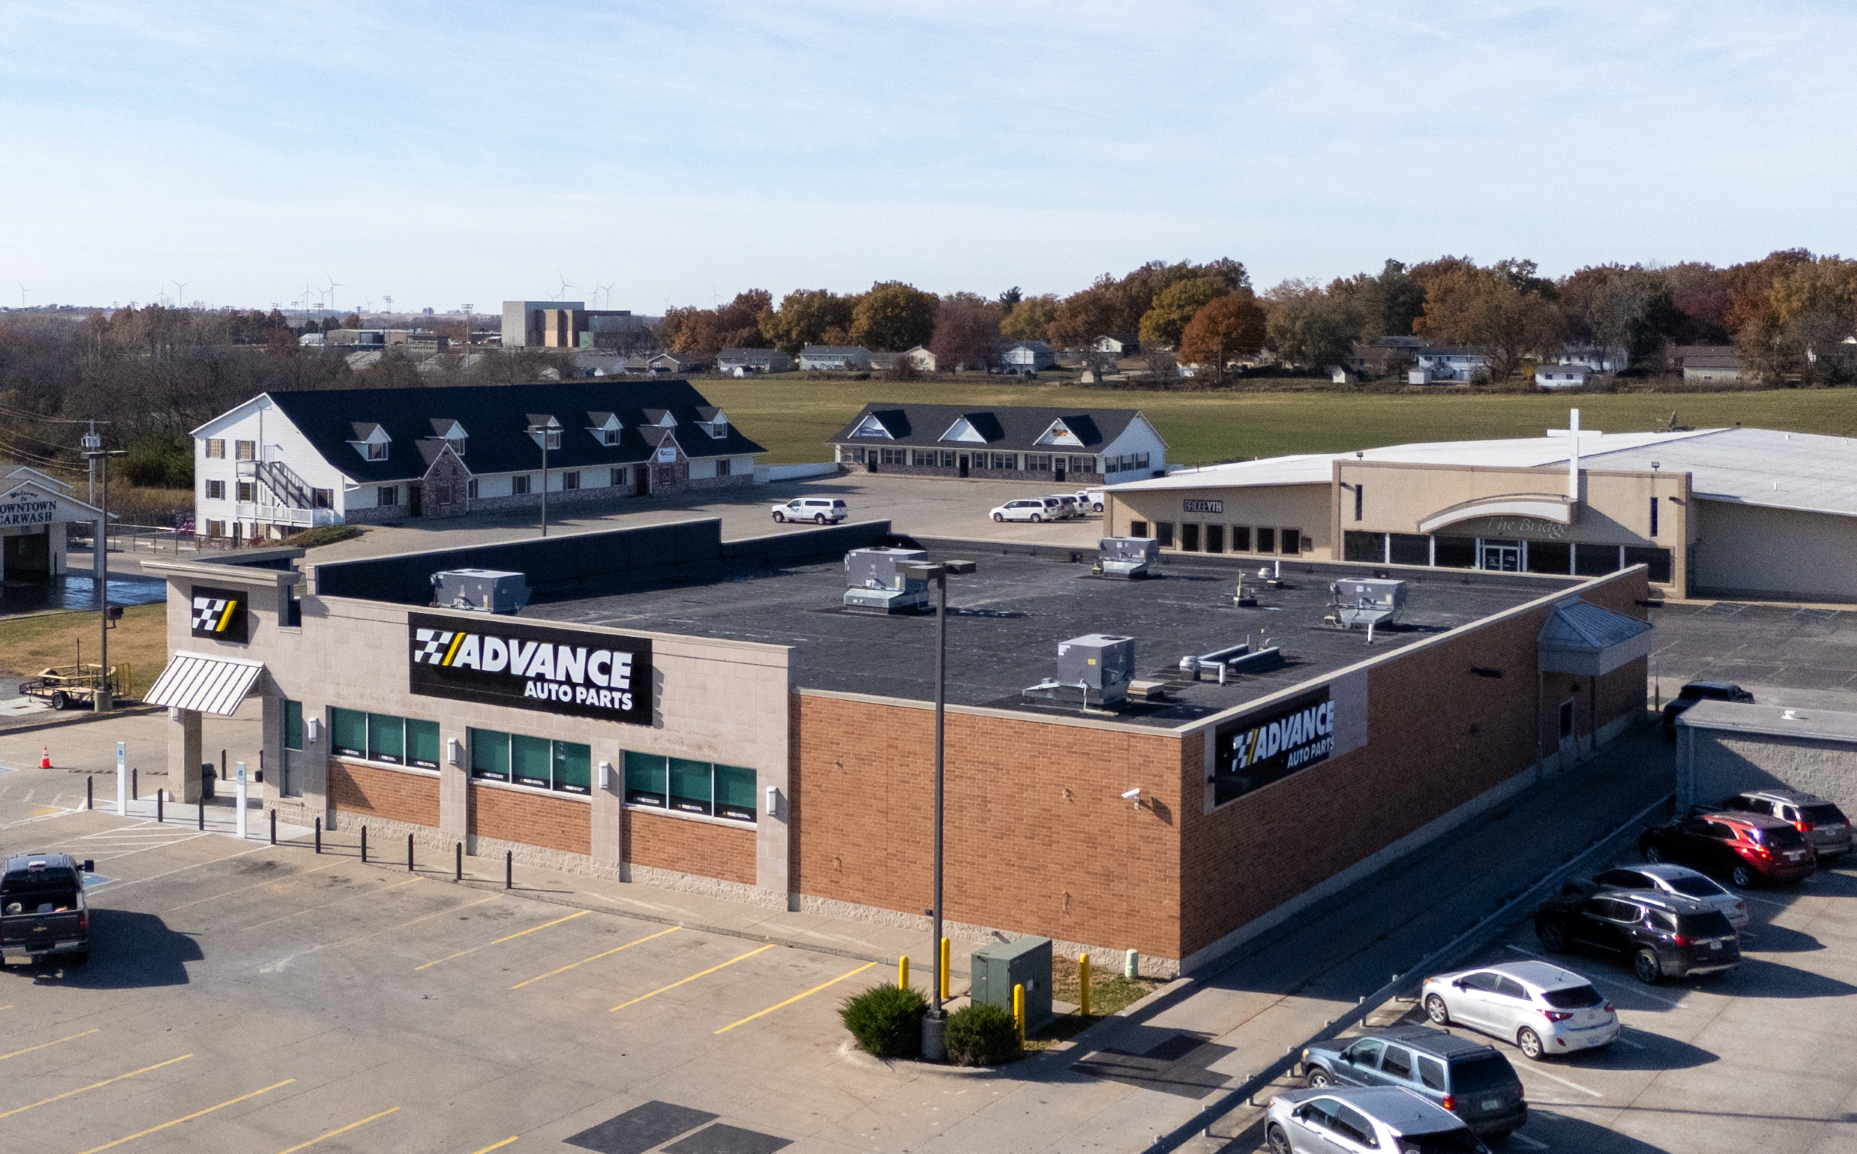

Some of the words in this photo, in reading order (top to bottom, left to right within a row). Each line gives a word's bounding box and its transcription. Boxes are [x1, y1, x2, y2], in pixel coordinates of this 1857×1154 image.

[0, 500, 56, 514] OWNTOWN
[1487, 516, 1515, 531] The
[1519, 518, 1568, 540] Bridge
[451, 634, 634, 690] ADVANCE
[524, 681, 573, 702] AUTO
[575, 688, 633, 711] PARTS
[1252, 700, 1335, 764] ADVANCE
[1287, 747, 1310, 769] AUTO
[1311, 736, 1335, 758] PARTS
